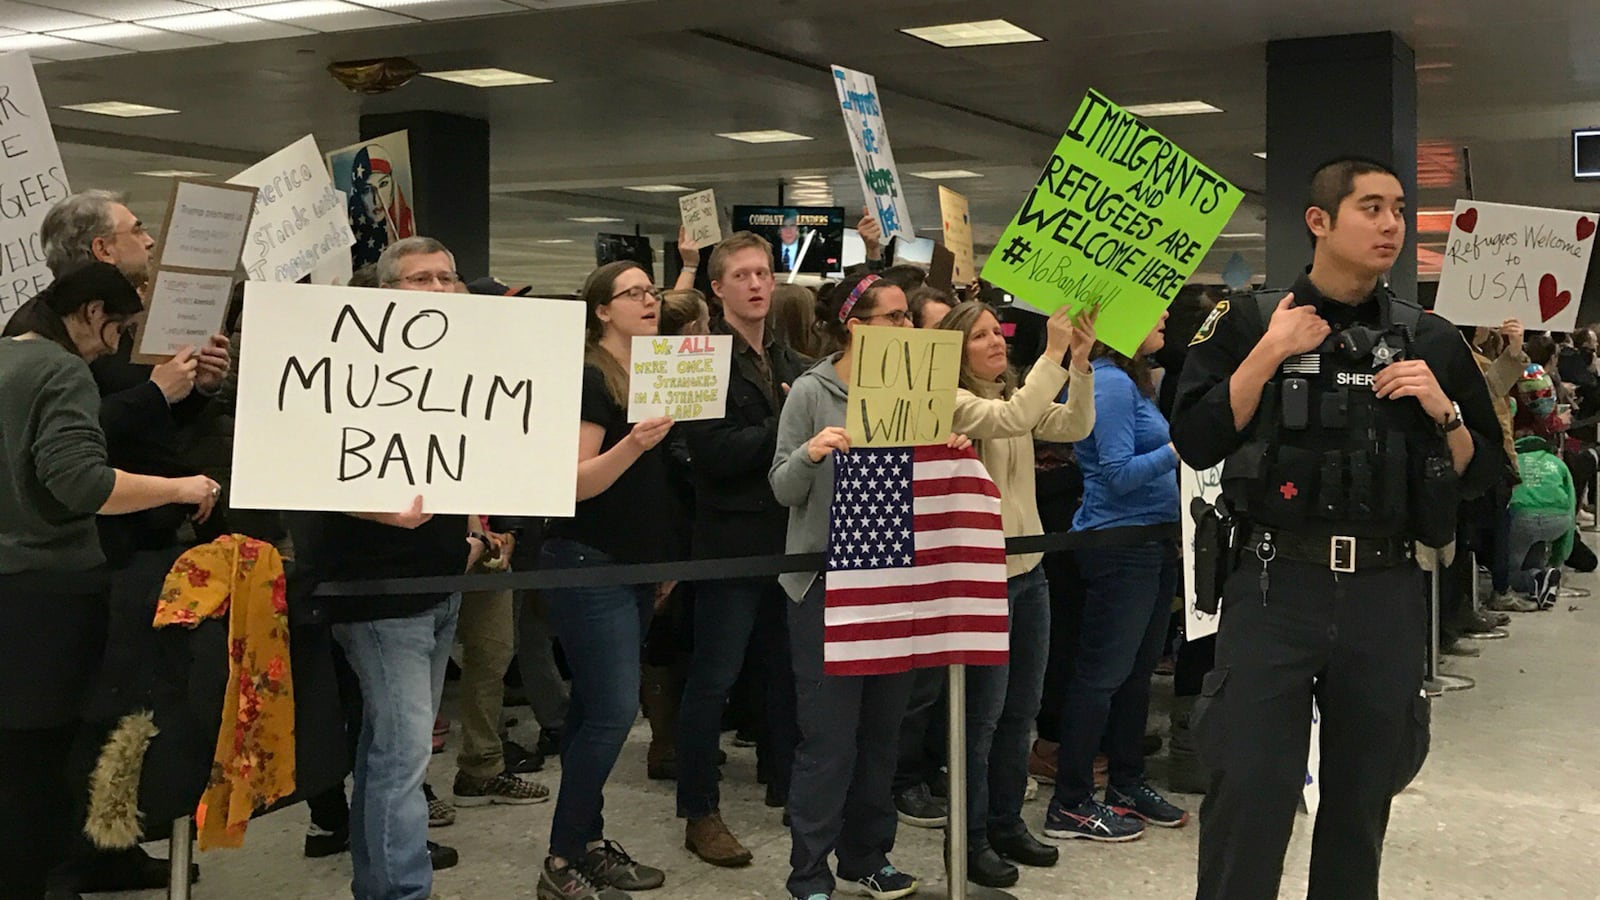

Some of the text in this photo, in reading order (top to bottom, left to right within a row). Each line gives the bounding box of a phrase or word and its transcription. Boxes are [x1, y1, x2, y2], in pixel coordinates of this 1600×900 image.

[1065, 91, 1228, 214] IMMIGRANTS
[255, 164, 312, 216] merica
[1037, 154, 1163, 240] REFUGEES
[1156, 228, 1202, 265] ARE
[1126, 179, 1164, 209] AND
[1017, 187, 1146, 277] WELCOME
[1132, 257, 1186, 300] HERE
[1447, 224, 1582, 265] Refugees Welcome
[1505, 252, 1521, 266] to
[1468, 272, 1529, 302] USA
[331, 301, 449, 353] NO
[678, 337, 715, 354] ALL
[634, 358, 713, 374] WERE ONCE
[857, 335, 957, 392] LOVE
[1337, 372, 1375, 386] SHER
[278, 355, 533, 435] MUSLIM
[651, 391, 662, 404] A
[665, 388, 719, 404] STRANGE
[664, 403, 703, 419] LAND
[861, 397, 941, 443] WINS
[337, 426, 466, 486] BAN
